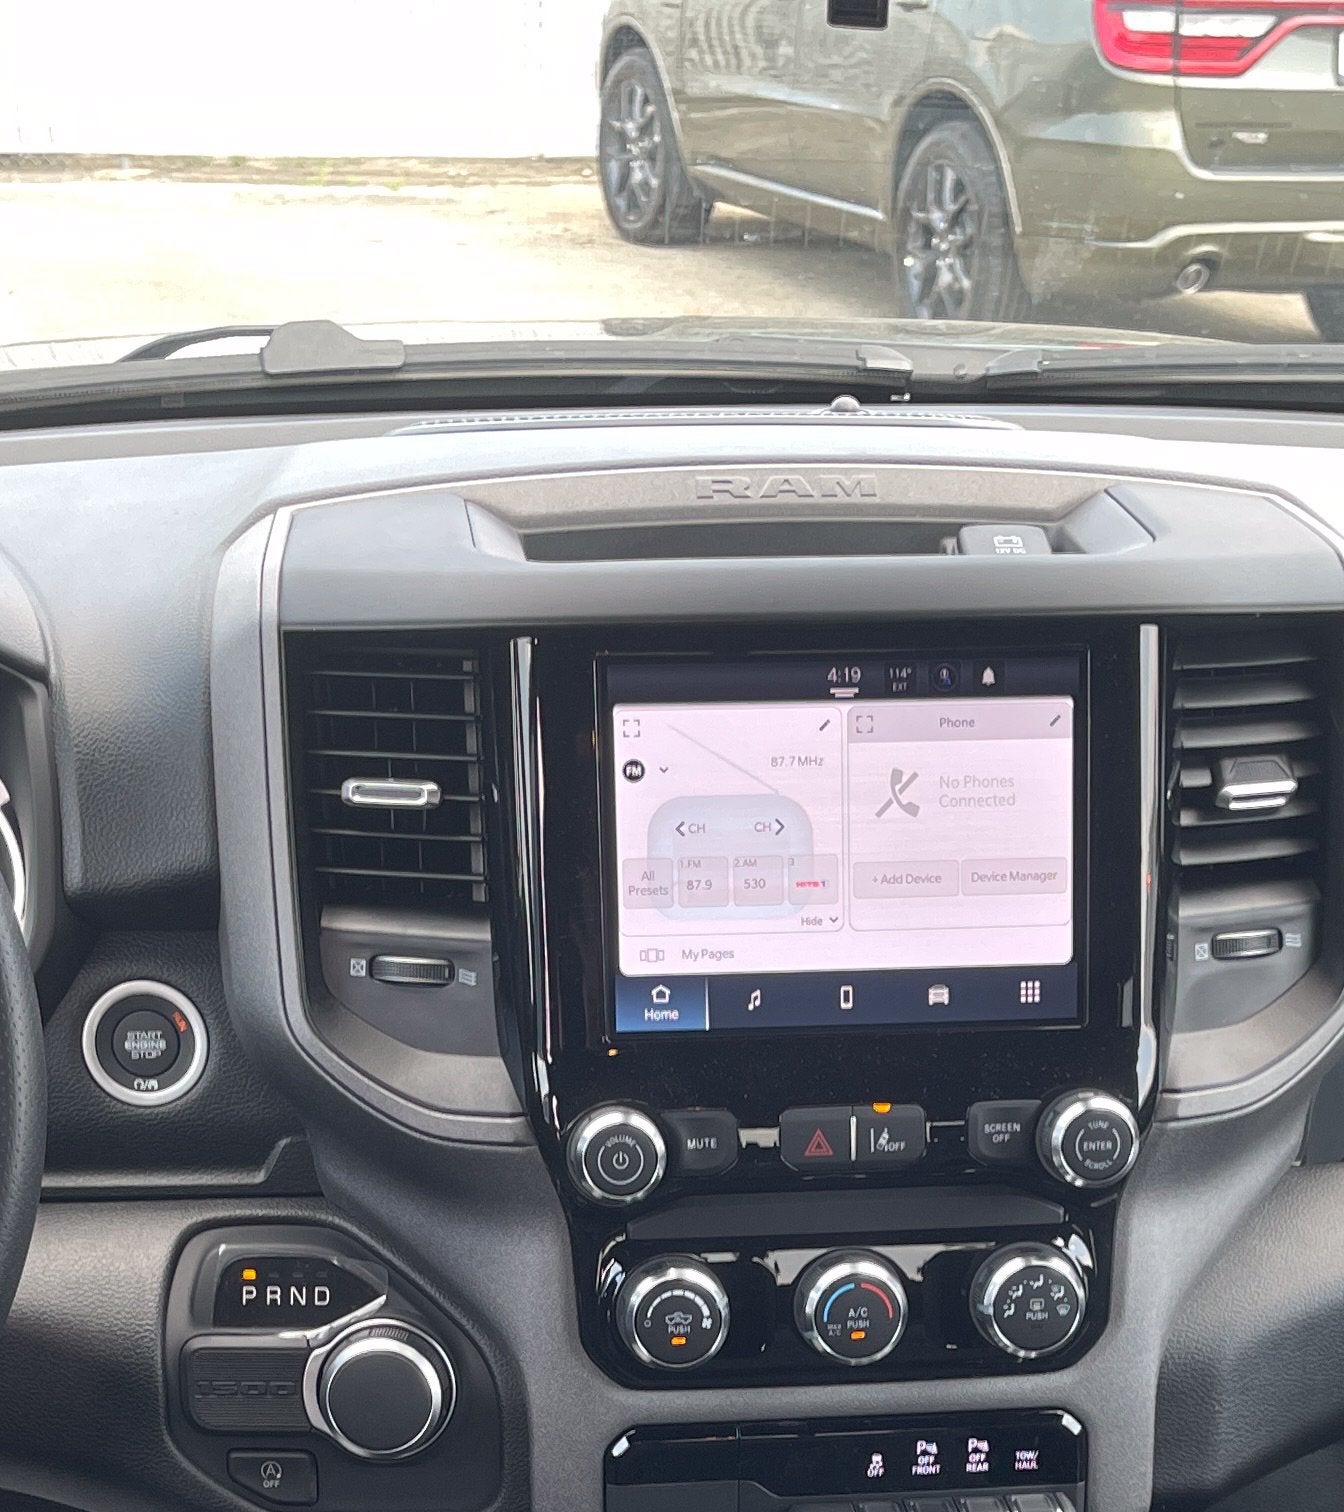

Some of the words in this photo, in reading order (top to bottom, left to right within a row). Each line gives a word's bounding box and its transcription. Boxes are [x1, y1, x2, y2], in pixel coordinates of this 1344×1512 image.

[695, 474, 877, 499] RAM
[827, 666, 862, 684] 4:19
[892, 681, 908, 693] EXT
[939, 717, 975, 728] Phone
[770, 756, 795, 768] 87.7
[797, 756, 824, 767] MHz
[625, 765, 643, 778] FM
[939, 776, 959, 789] No
[963, 774, 1015, 789] Phones
[938, 793, 1016, 808] Connected
[688, 823, 706, 834] CH
[754, 821, 772, 832] CH
[641, 871, 655, 881] All
[881, 872, 904, 884] Add
[906, 872, 942, 884] Device
[971, 870, 1007, 882] Device
[1009, 869, 1058, 884] Manager
[686, 879, 713, 890] 87.9
[744, 878, 766, 889] 530
[628, 885, 669, 896] Presets
[801, 916, 823, 926] Hide
[682, 949, 699, 961] My
[701, 948, 735, 961] Pages
[644, 1008, 679, 1021] Home
[127, 1030, 162, 1040] START
[125, 1040, 167, 1050] ENGINE
[131, 1050, 161, 1060] STOP
[984, 1122, 1020, 1134] SCREEN
[605, 1134, 637, 1148] VOLUME
[992, 1133, 1010, 1143] OFF
[687, 1138, 717, 1150] MUTE
[888, 1141, 906, 1152] OFF
[1083, 1140, 1112, 1151] ENTER
[848, 1307, 868, 1318] A/C
[1025, 1312, 1048, 1320] PUSH
[668, 1324, 691, 1334] PUSH
[847, 1318, 870, 1329] PUSH
[918, 1455, 935, 1465] OFF
[969, 1452, 986, 1463] OFF
[867, 1467, 884, 1478] OFF
[912, 1464, 940, 1476] FRONT
[966, 1462, 989, 1473] REAR
